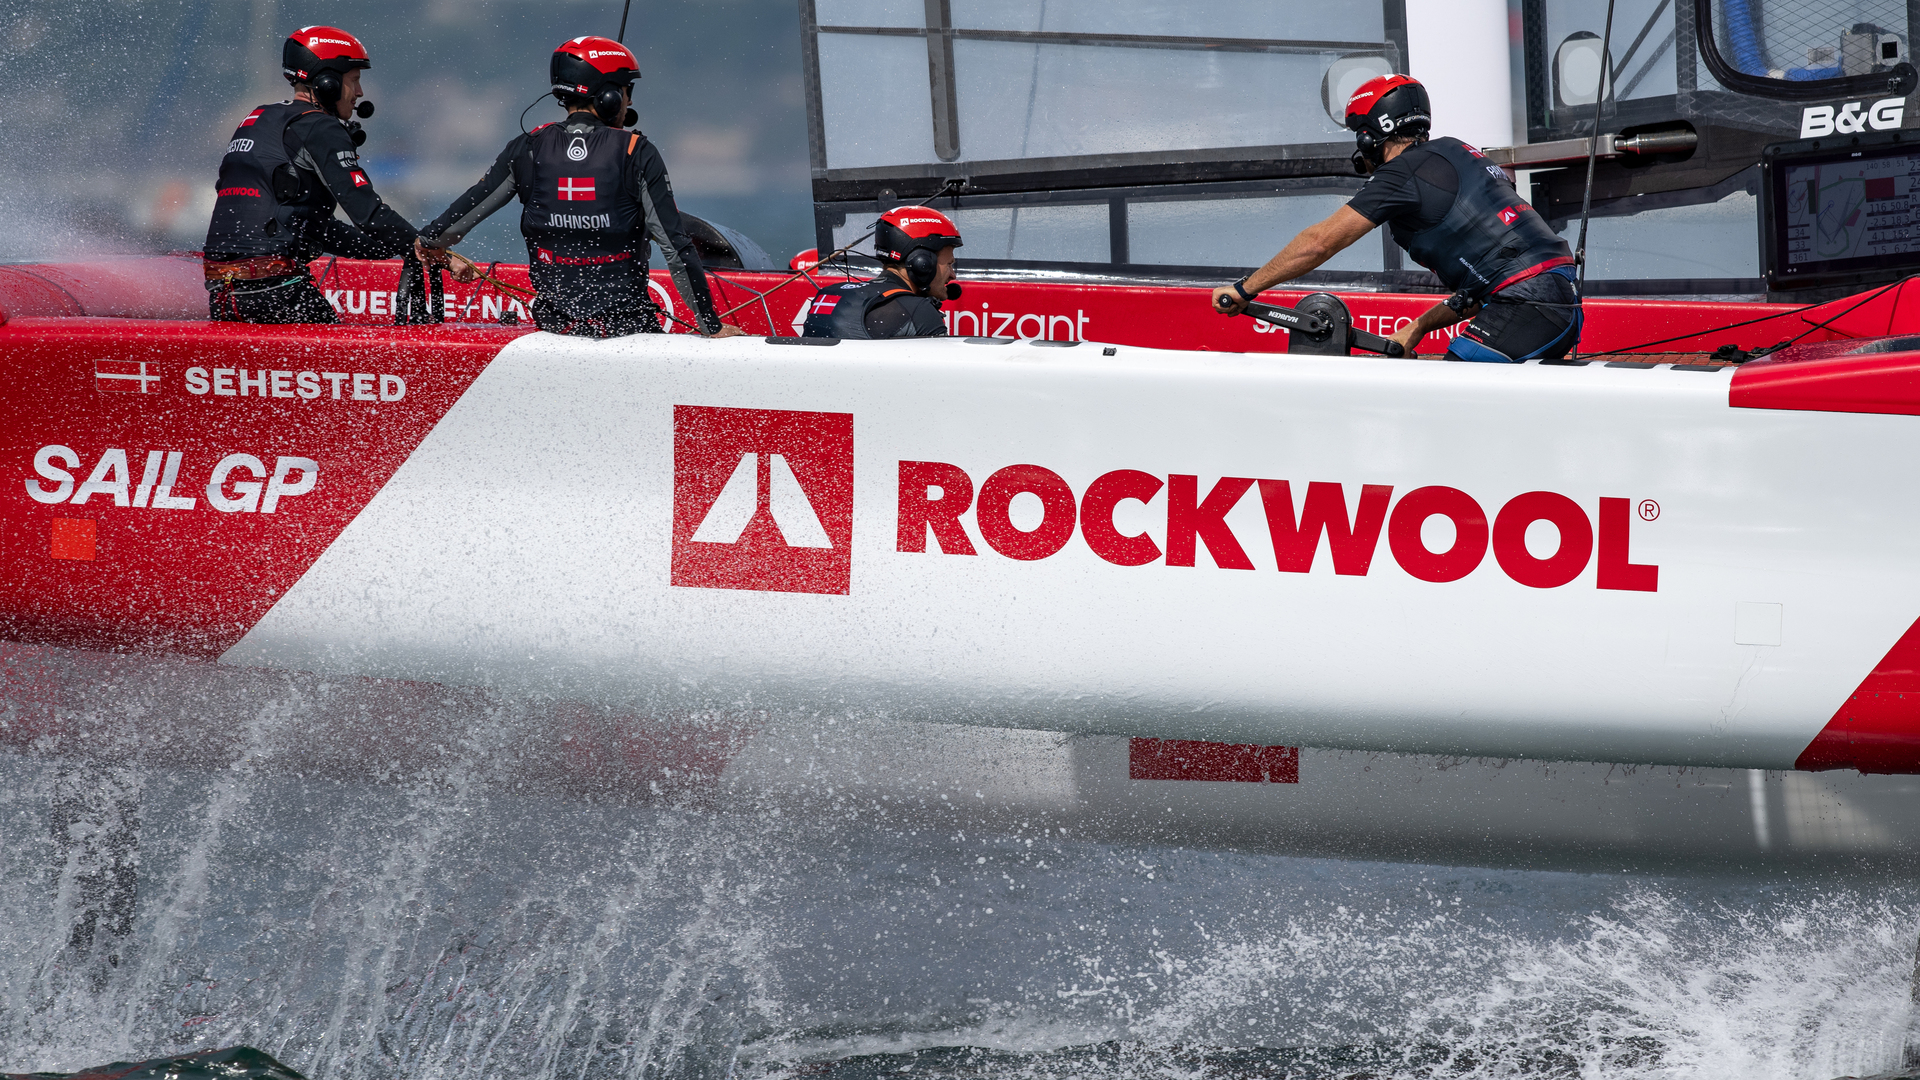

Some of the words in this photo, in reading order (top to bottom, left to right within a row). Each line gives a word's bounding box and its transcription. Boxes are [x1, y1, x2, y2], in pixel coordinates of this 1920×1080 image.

[319, 38, 351, 46] ROCKWOOL
[1378, 113, 1395, 132] 5
[1800, 97, 1905, 138] B&G
[1866, 162, 1878, 170] 140
[1870, 203, 1887, 213] 116
[1890, 201, 1909, 211] 50.8
[548, 213, 610, 230] JOHNSON
[1795, 229, 1805, 237] 34
[1795, 241, 1805, 249] 33
[555, 251, 633, 265] ROCKWOOL
[1268, 310, 1299, 323] HARKEN
[185, 366, 407, 402] SEHESTED
